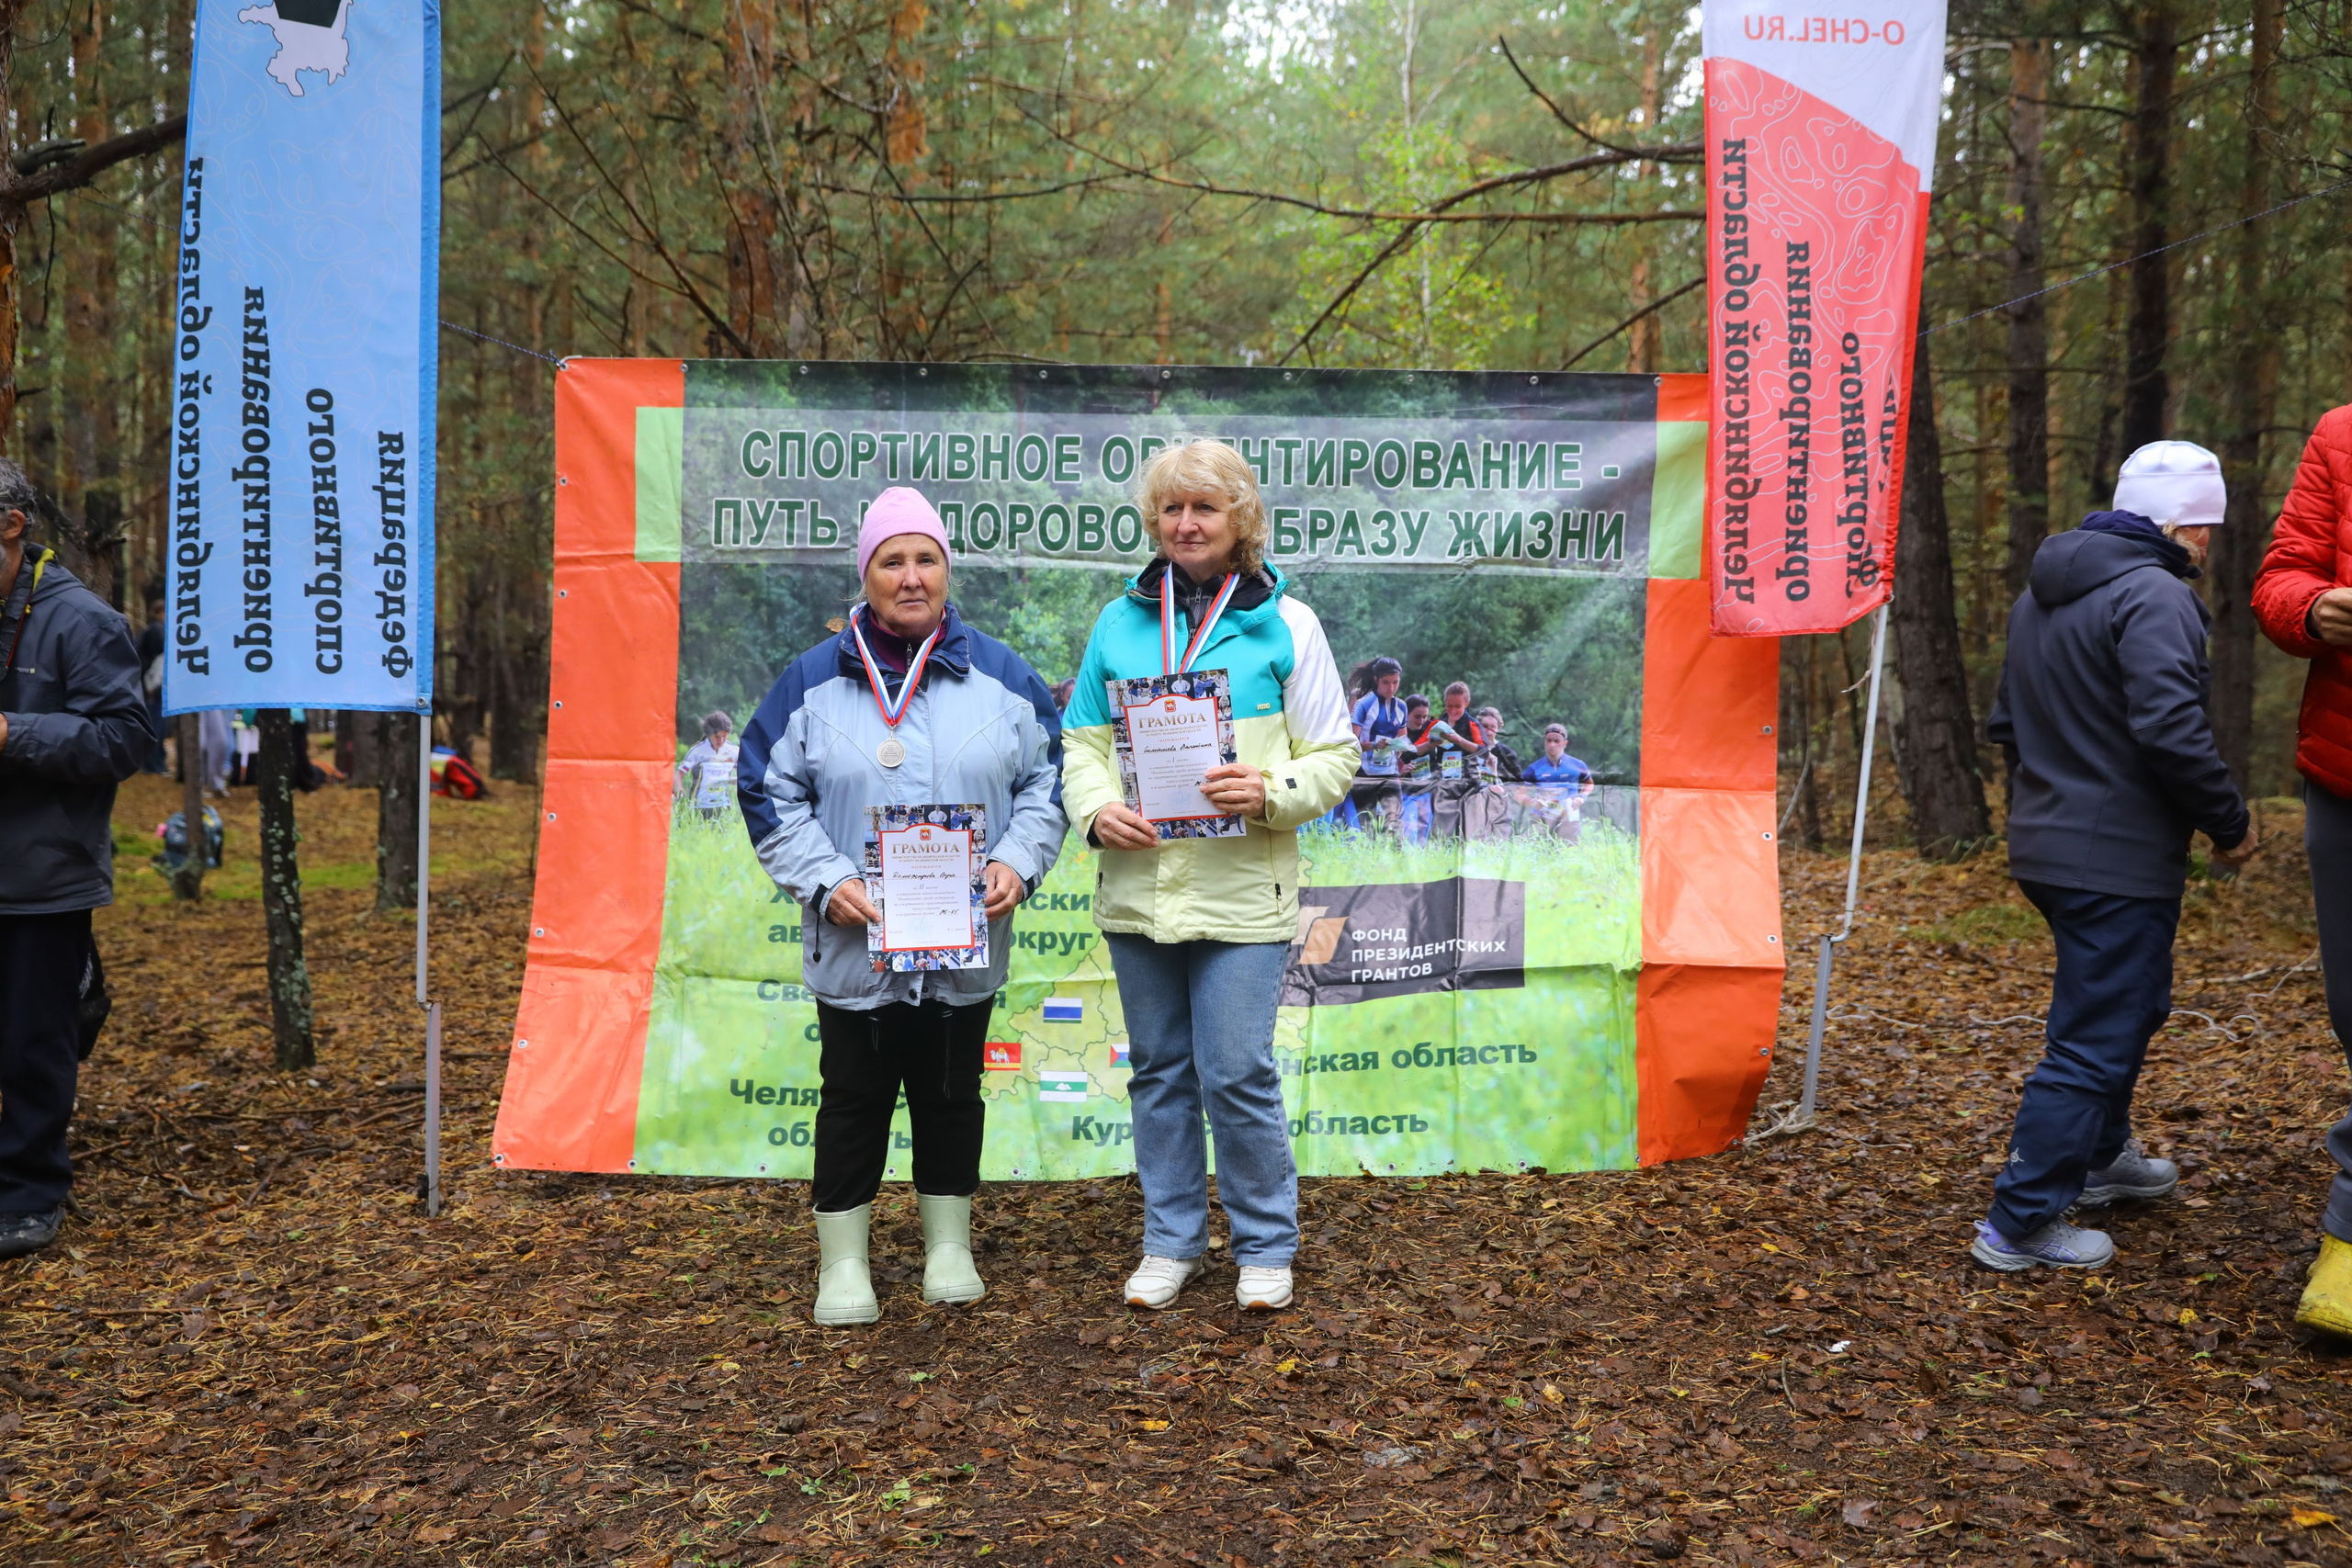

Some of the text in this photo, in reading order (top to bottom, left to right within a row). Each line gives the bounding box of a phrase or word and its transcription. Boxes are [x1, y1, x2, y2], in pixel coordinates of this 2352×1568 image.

[741, 429, 1082, 483] СПОРТИВНОЕ
[712, 497, 840, 548] ПУТЬ
[1272, 507, 1430, 558] БРАЗУ
[1444, 509, 1628, 562] ЖИЗНИ
[1138, 712, 1206, 728] ГРАМОТА
[891, 842, 960, 854] ГРАМОТА
[1351, 928, 1408, 942] ФОНД
[1351, 938, 1507, 963] ПРЕЗИДЕНТСКИХ
[1351, 962, 1433, 983] ГРАНТОВ
[1391, 1042, 1538, 1069] область
[1287, 1110, 1429, 1138] область
